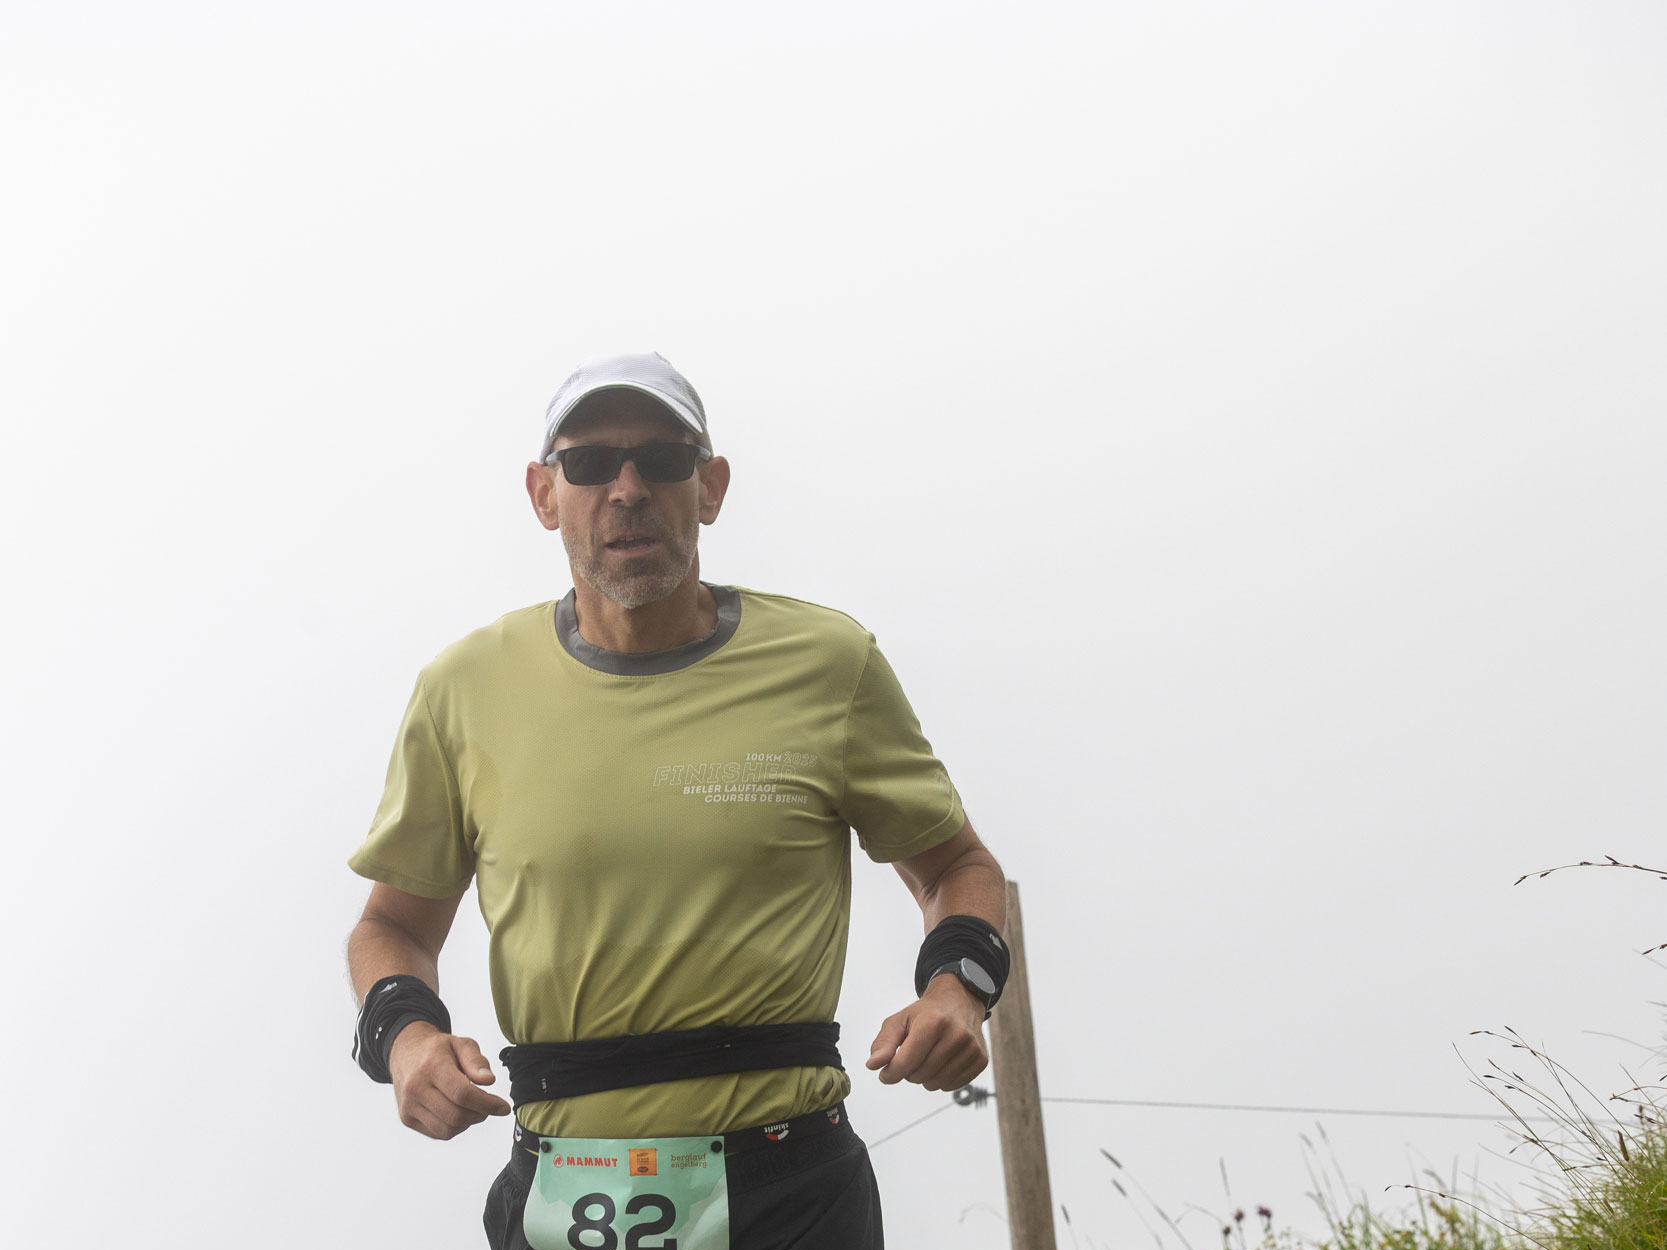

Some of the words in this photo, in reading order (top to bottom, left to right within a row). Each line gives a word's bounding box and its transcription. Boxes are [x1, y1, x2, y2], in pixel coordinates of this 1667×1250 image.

[745, 753, 765, 761] 100
[766, 754, 782, 762] KM
[653, 762, 797, 787] FINISHER
[683, 784, 721, 795] BIELER
[724, 784, 777, 793] LAUFTAGE
[704, 794, 757, 803] COURSES
[760, 794, 773, 803] DE
[775, 794, 809, 804] BIENNE
[566, 1156, 618, 1168] MAMMUT
[671, 1152, 707, 1162] berglauf
